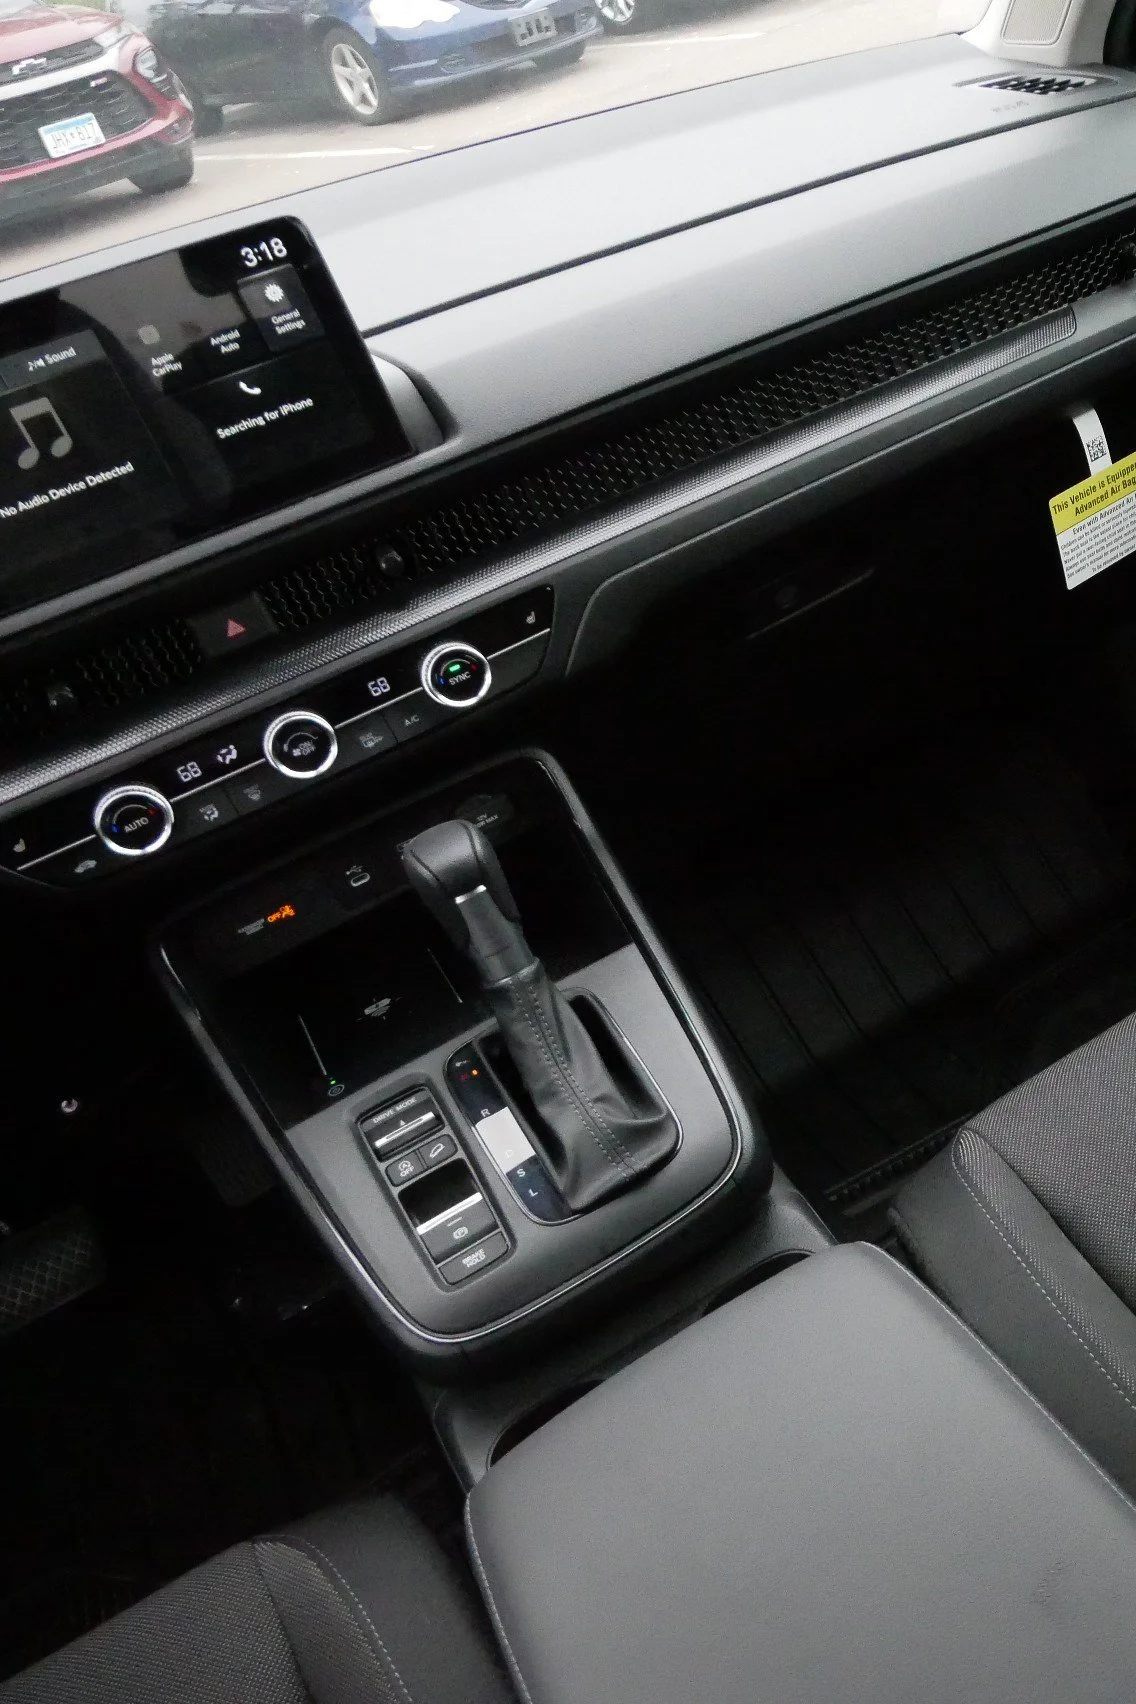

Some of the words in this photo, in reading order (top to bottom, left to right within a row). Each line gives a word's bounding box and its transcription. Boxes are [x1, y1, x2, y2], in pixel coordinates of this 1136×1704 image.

[240, 237, 288, 268] 3:18
[271, 309, 301, 325] General
[275, 319, 306, 334] Settings
[210, 329, 241, 347] Android
[45, 346, 77, 365] Sound
[220, 342, 240, 354] Auto
[151, 353, 174, 367] Apple
[152, 361, 183, 377] CarPlay
[216, 415, 266, 439] Searching
[263, 409, 280, 422] for
[279, 397, 314, 417] iPhone
[0, 507, 18, 518] No
[18, 493, 50, 512] Audio
[49, 480, 87, 500] Device
[85, 461, 135, 487] Detected
[1052, 501, 1069, 515] This
[1069, 485, 1097, 505] Vehicle
[1098, 480, 1106, 490] is
[1075, 491, 1109, 516] Advanced
[1109, 485, 1121, 497] Air
[367, 676, 391, 697] 68
[449, 671, 473, 686] SYNC
[404, 714, 420, 727] A/C
[175, 761, 202, 783] 68
[123, 817, 149, 833] AUTO
[373, 1109, 395, 1124] DRIVE
[480, 1108, 491, 1117] R
[400, 1166, 415, 1177] OFF
[516, 1168, 526, 1177] S
[528, 1188, 539, 1197] L
